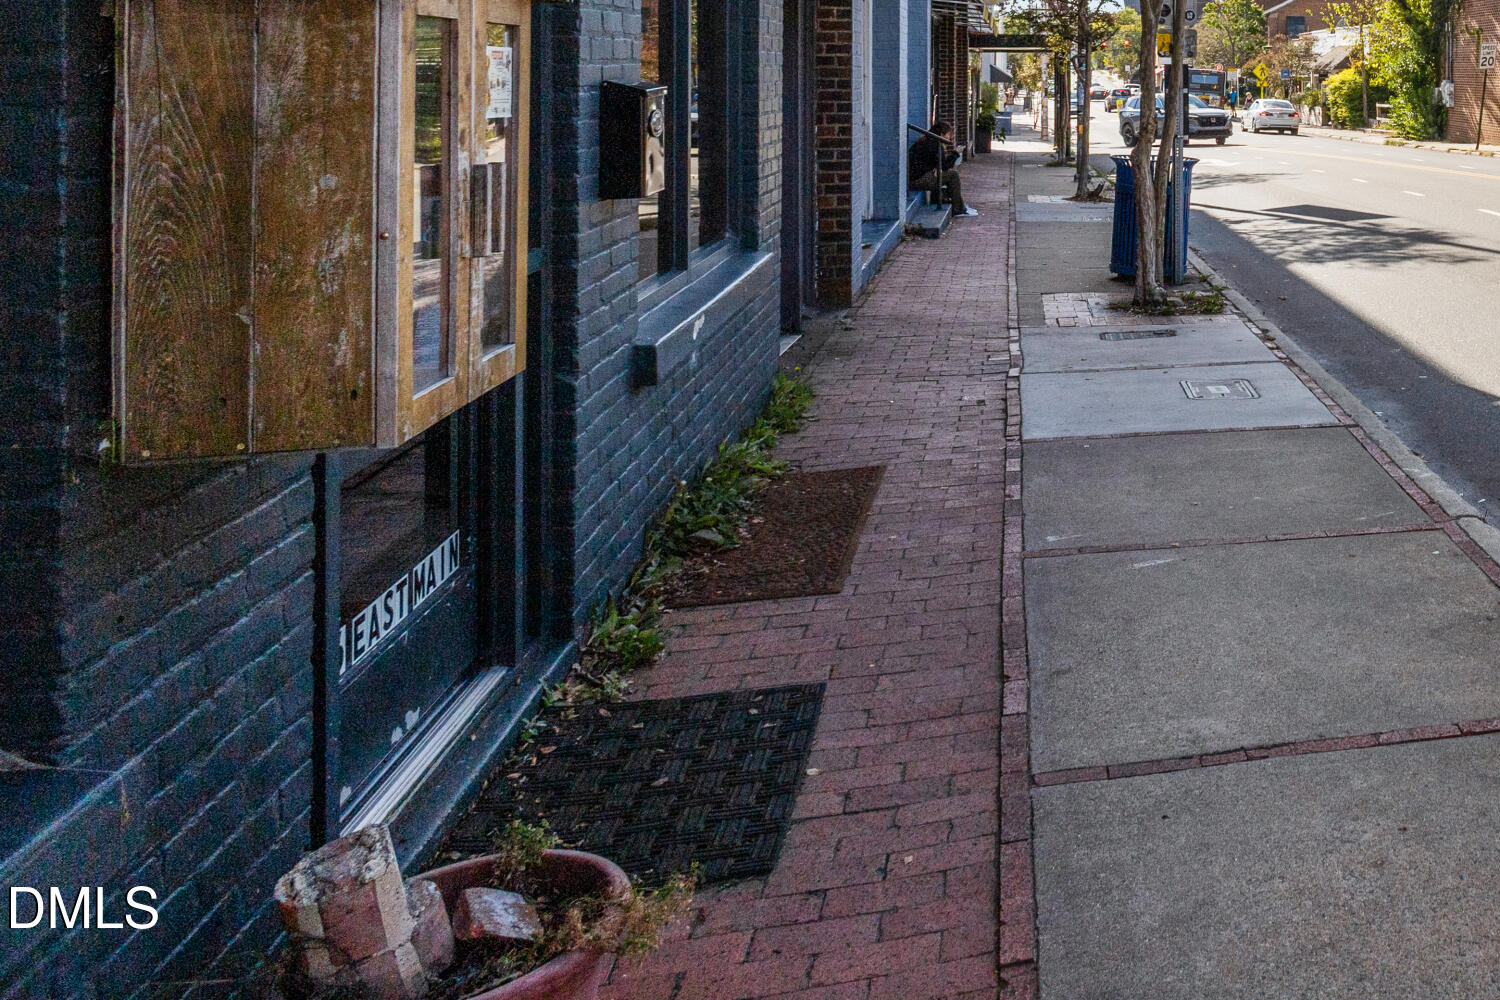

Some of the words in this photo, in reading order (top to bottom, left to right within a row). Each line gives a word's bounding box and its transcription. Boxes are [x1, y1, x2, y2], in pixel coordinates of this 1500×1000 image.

[1481, 56, 1494, 66] 20
[354, 579, 409, 661] EAST
[414, 537, 460, 607] MAIN
